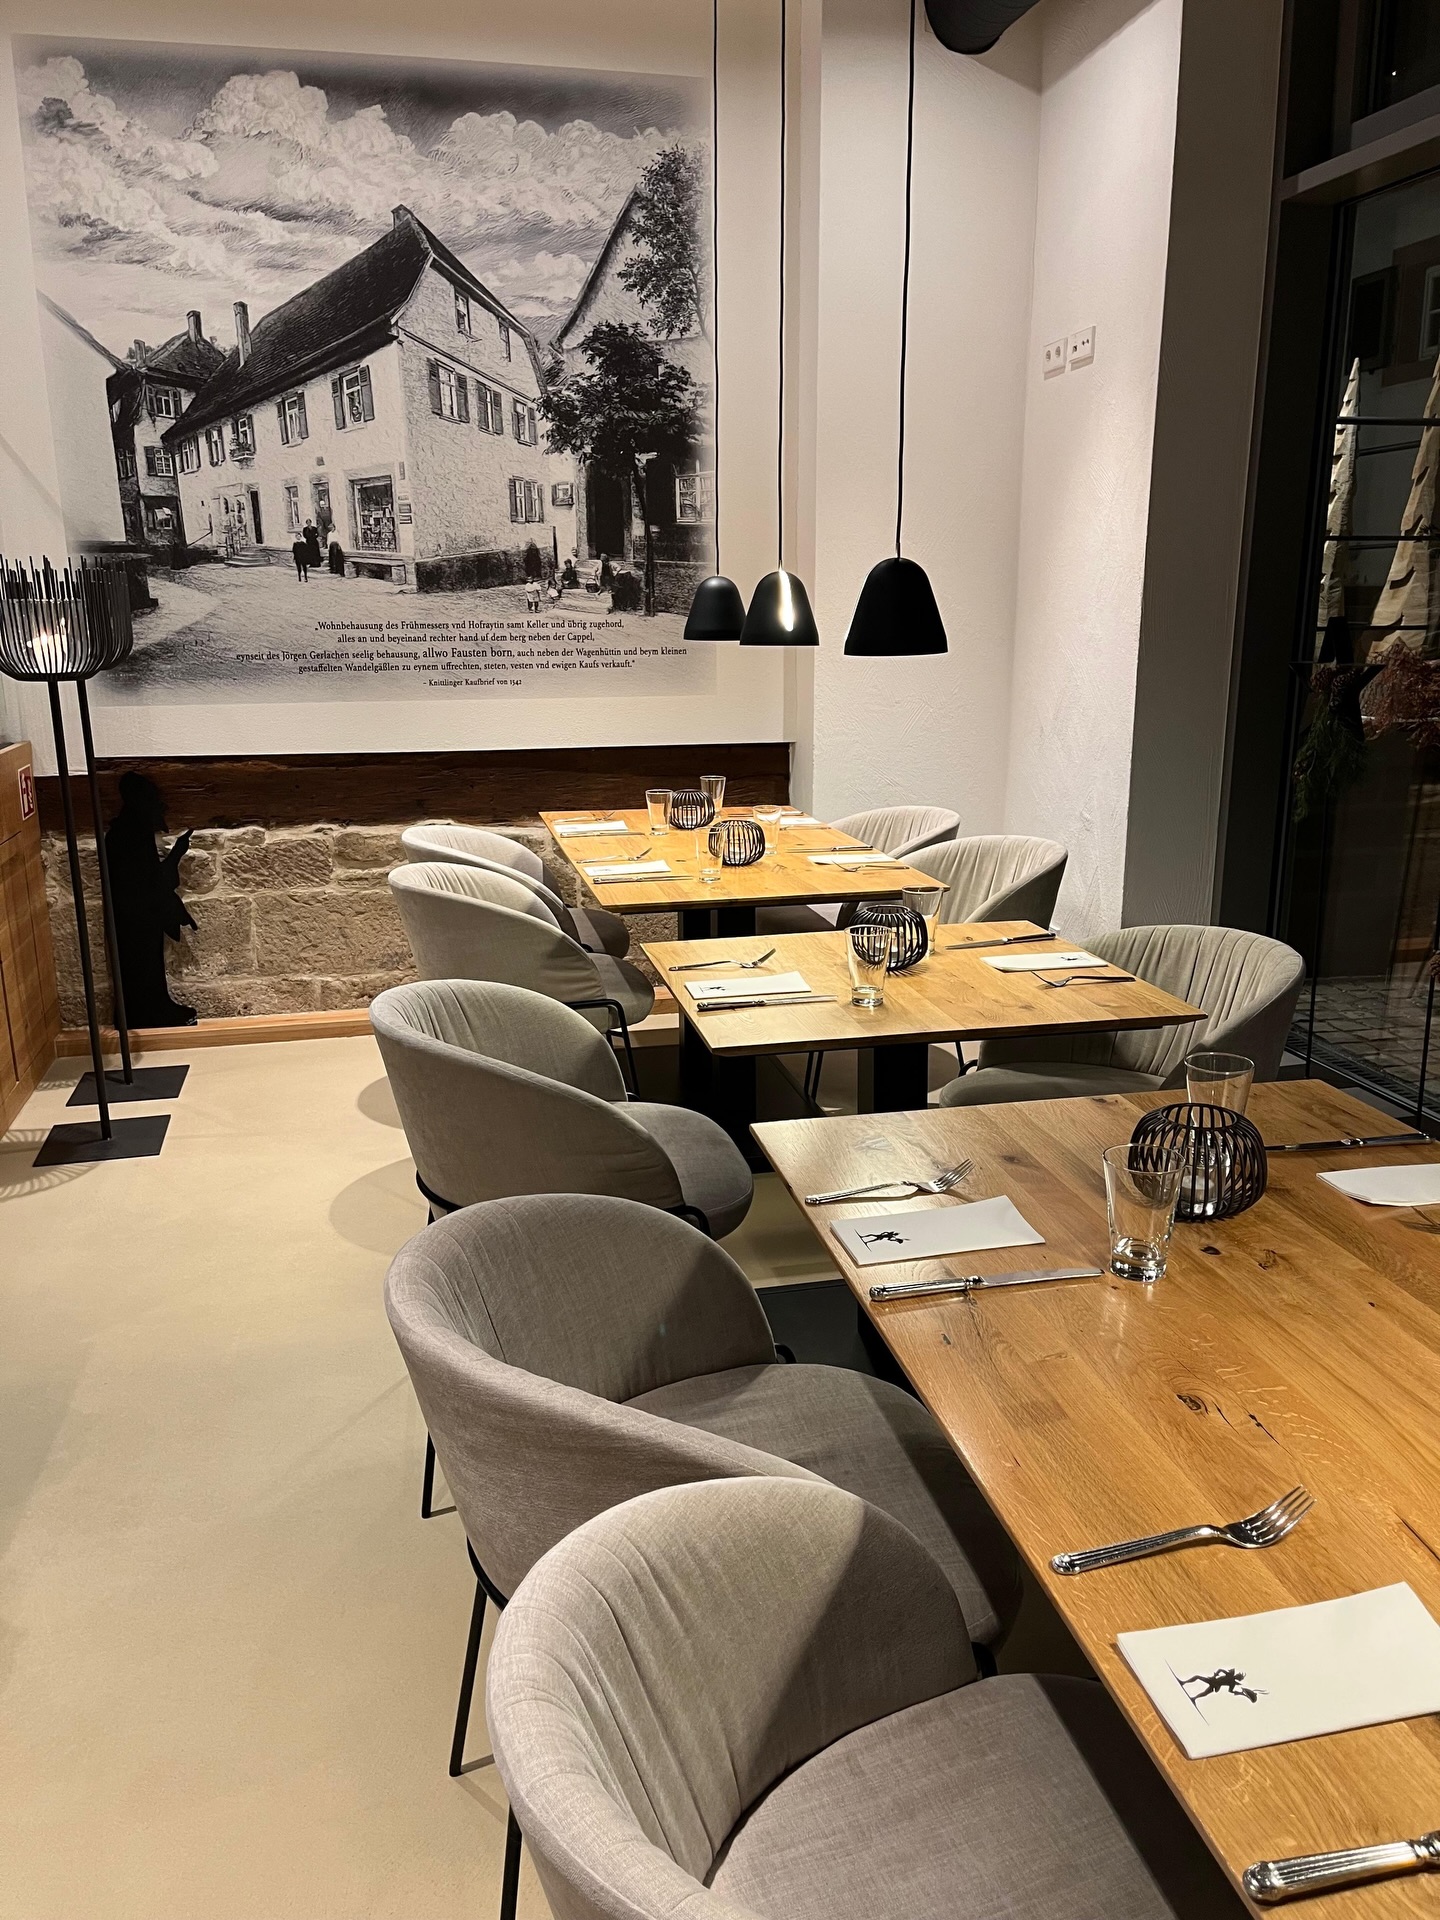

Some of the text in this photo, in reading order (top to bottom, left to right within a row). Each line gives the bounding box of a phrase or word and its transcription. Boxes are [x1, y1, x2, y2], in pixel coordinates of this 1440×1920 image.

[386, 621, 398, 629] des
[401, 621, 449, 629] Frühmessers
[452, 621, 466, 629] vnd
[468, 620, 504, 630] Hofraytin
[527, 620, 549, 628] Keller
[568, 620, 587, 630] übrig
[589, 619, 624, 630] zugehord,
[338, 634, 355, 643] alles
[370, 634, 384, 642] und
[388, 634, 426, 644] beyeinand
[429, 634, 456, 642] rechter
[459, 633, 478, 642] hand
[481, 633, 489, 641] uf
[491, 633, 507, 641] dem
[510, 633, 526, 643] berg
[528, 633, 550, 641] neben
[553, 632, 565, 641] der
[567, 632, 595, 642] Cappel,
[236, 652, 264, 662] eynseit
[266, 651, 280, 660] des
[310, 651, 349, 659] Gerlachen
[352, 650, 374, 661] seelig
[376, 650, 420, 660] behausung,
[422, 648, 448, 658] allwo
[452, 648, 487, 657] Fausten
[490, 647, 515, 658] born,
[517, 649, 534, 657] auch
[537, 648, 559, 656] neben
[561, 648, 573, 656] der
[576, 648, 621, 658] Wagenhüttin
[624, 647, 637, 656] und
[639, 647, 658, 657] beym
[661, 647, 687, 655] kleinen
[299, 663, 342, 674] gestaffelten
[345, 663, 399, 673] Wandelgäßlen
[442, 662, 481, 670] uffrechten,
[536, 661, 549, 669] vnd
[552, 661, 577, 671] ewigen
[579, 660, 599, 669] Kaufs
